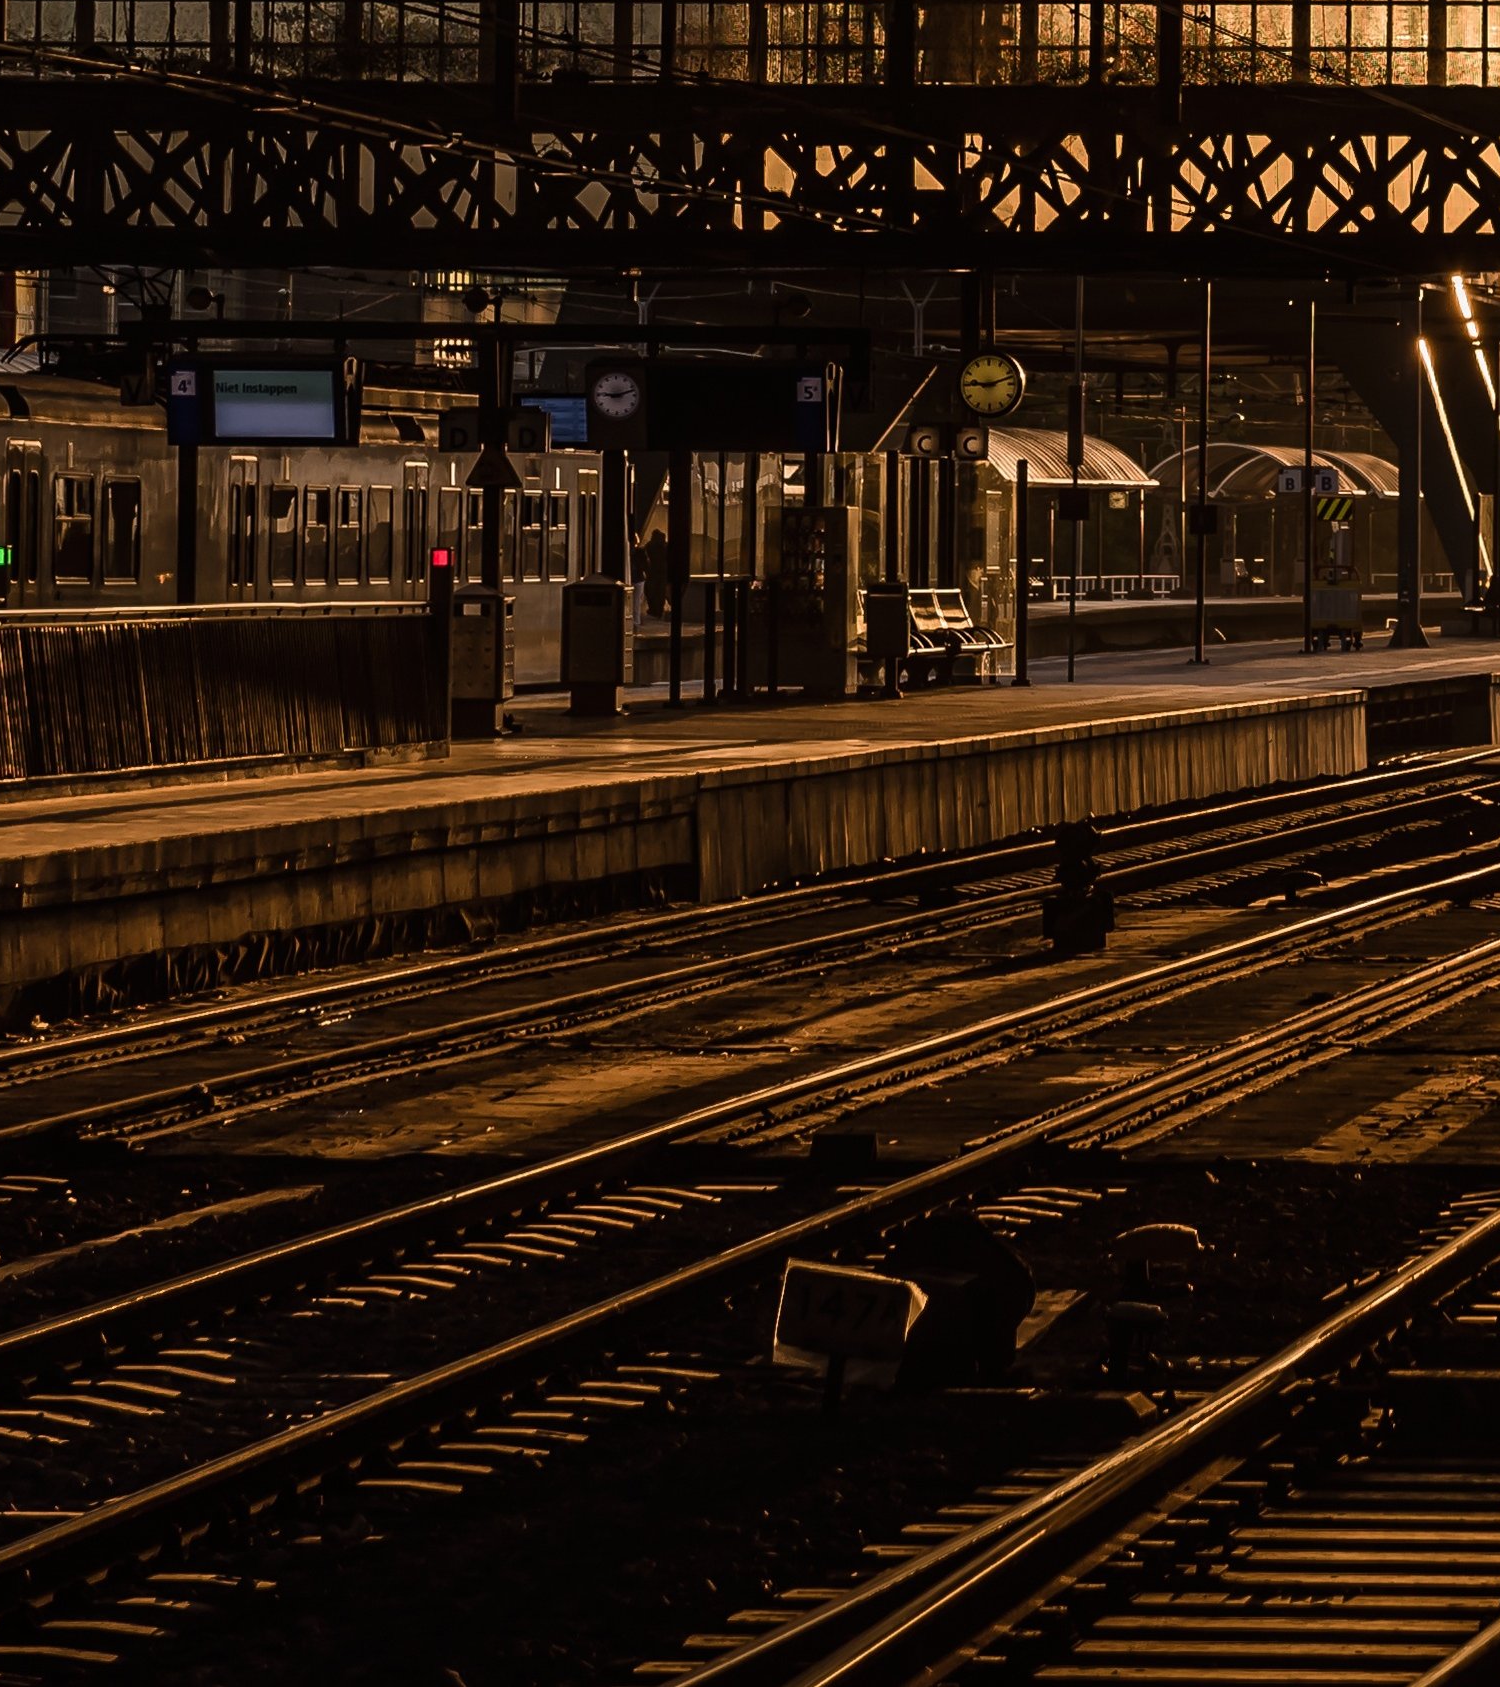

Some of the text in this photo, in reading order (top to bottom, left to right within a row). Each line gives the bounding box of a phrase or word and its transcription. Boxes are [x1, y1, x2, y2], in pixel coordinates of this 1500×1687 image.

[216, 383, 298, 396] Niet Instappen
[450, 427, 467, 450] D
[518, 427, 537, 449] D
[918, 435, 932, 453] C
[963, 436, 977, 454] C
[1285, 477, 1295, 490] B
[1322, 476, 1332, 491] B
